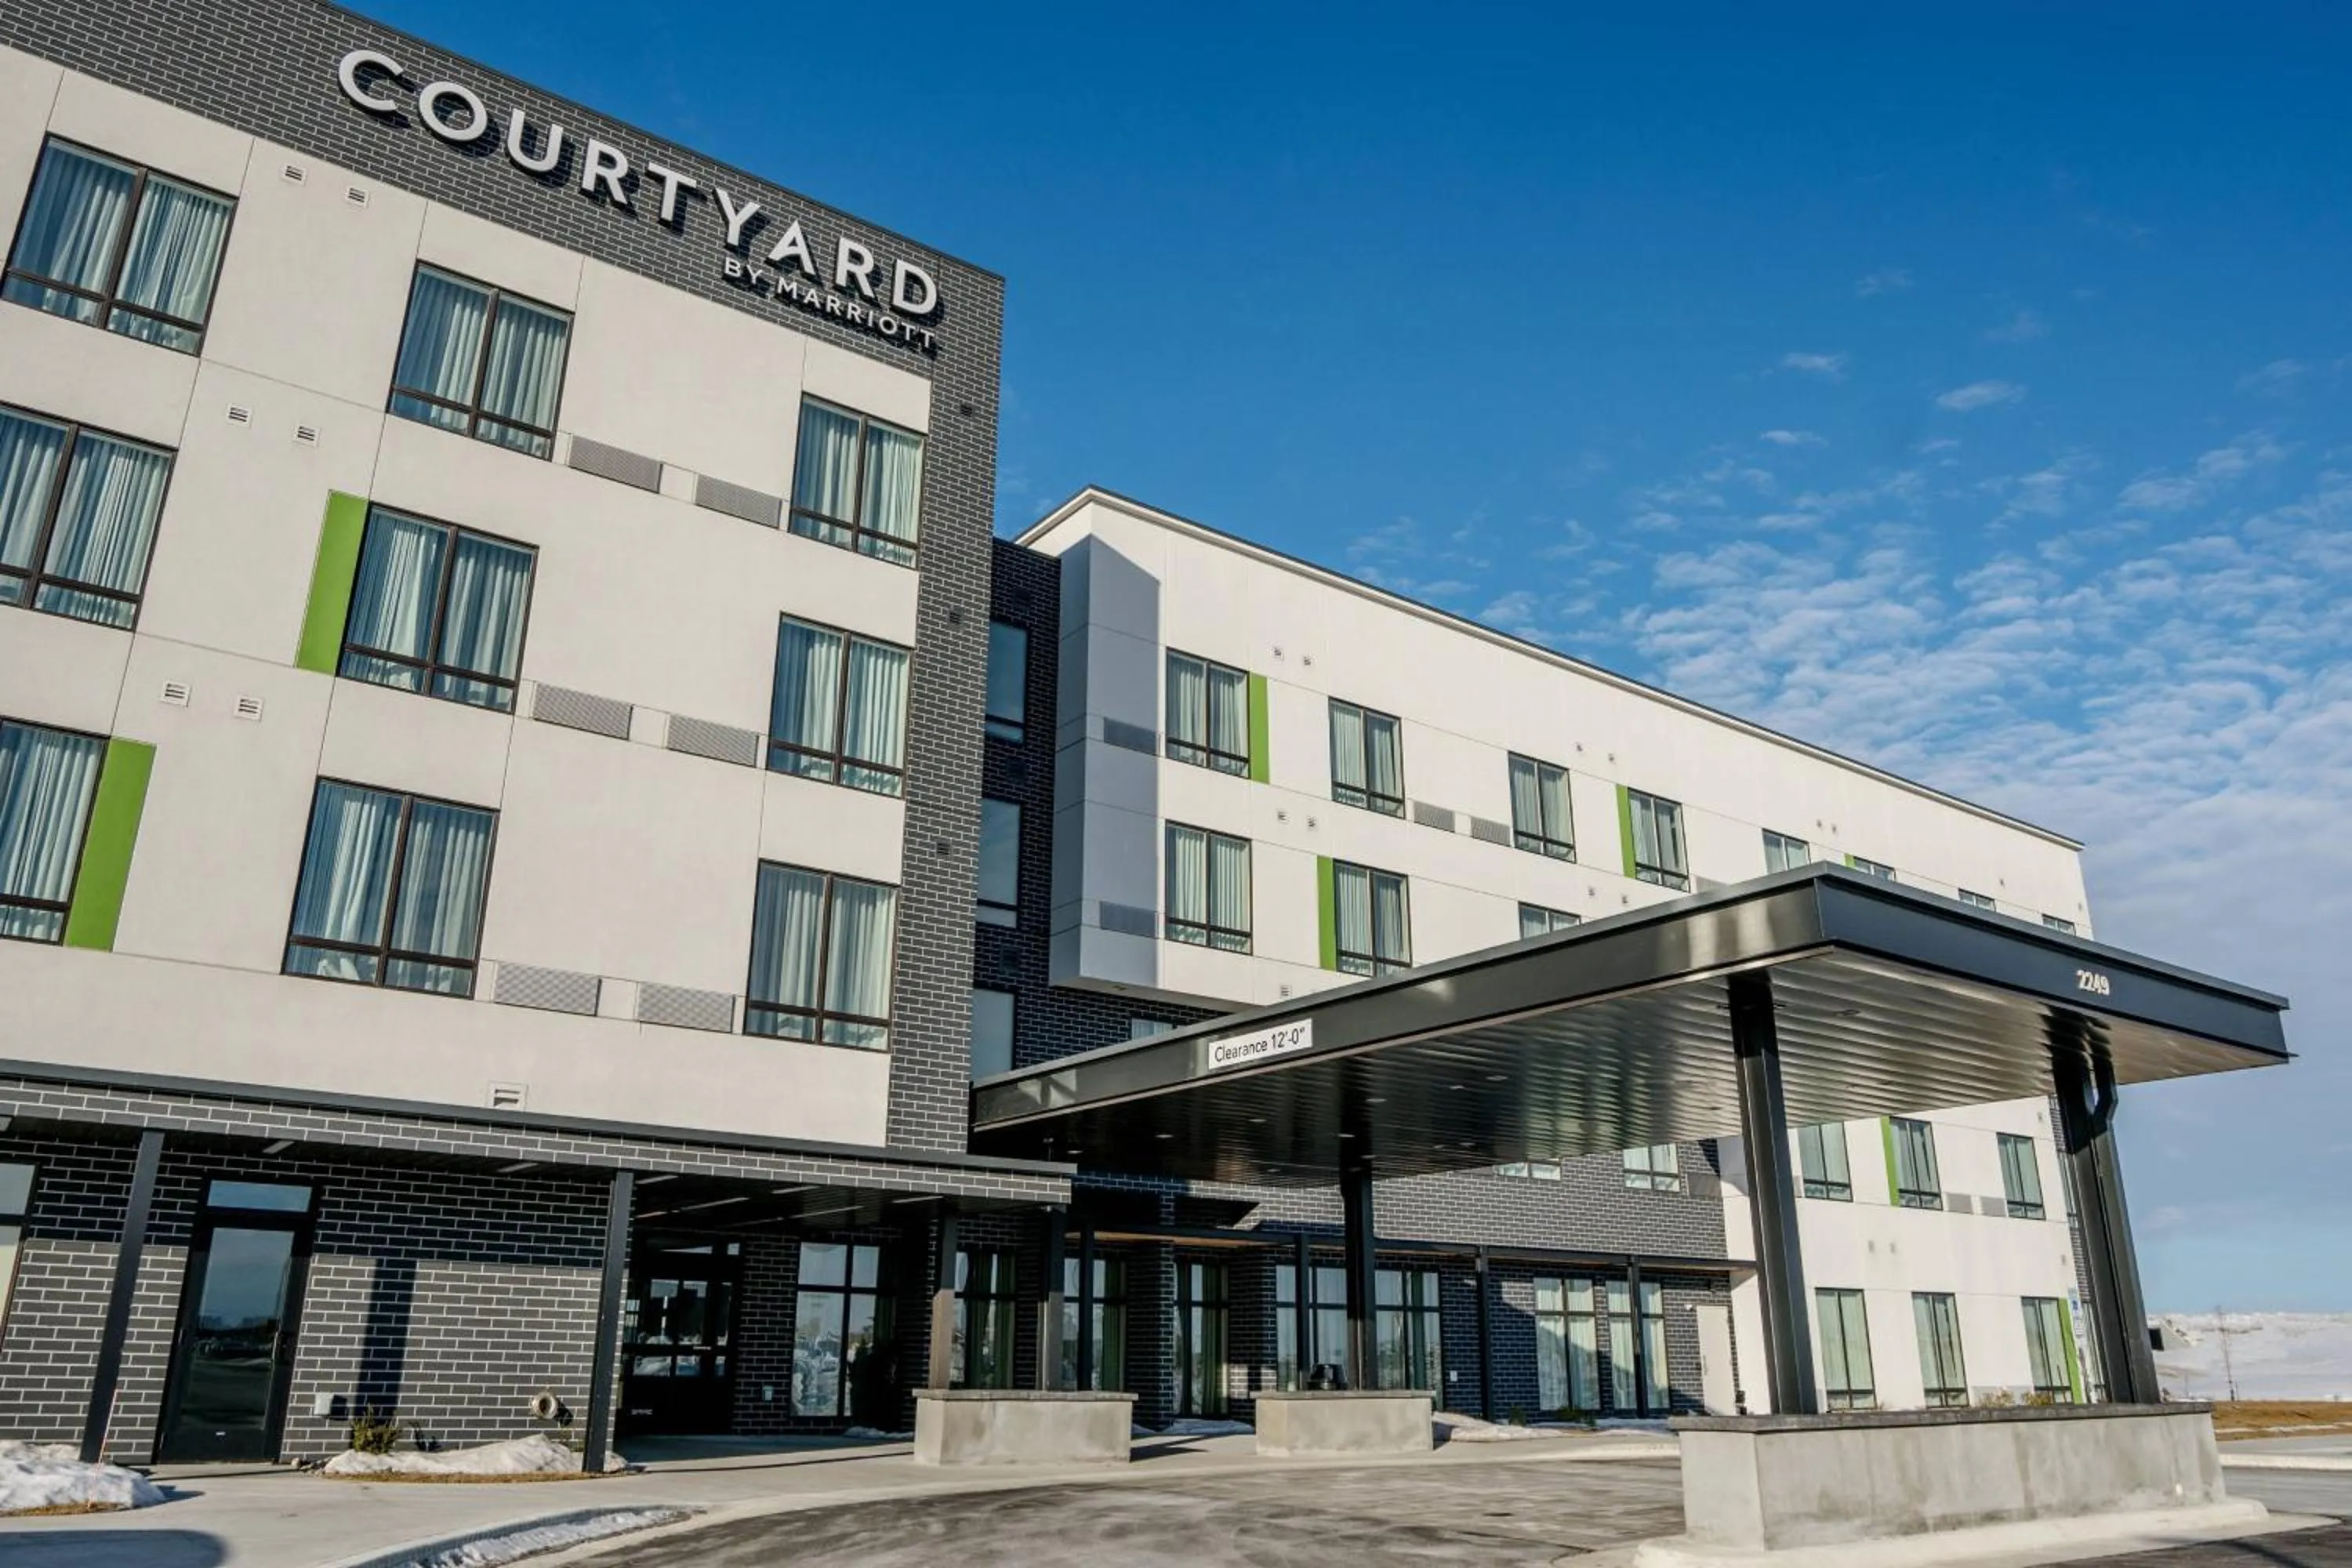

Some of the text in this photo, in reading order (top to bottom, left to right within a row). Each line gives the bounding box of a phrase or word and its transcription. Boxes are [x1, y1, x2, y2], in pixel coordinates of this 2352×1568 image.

[337, 49, 938, 314] COURTYARD
[724, 257, 935, 349] BY MARRIOTT
[2076, 969, 2110, 995] 2249
[1214, 1040, 1269, 1062] Clearance
